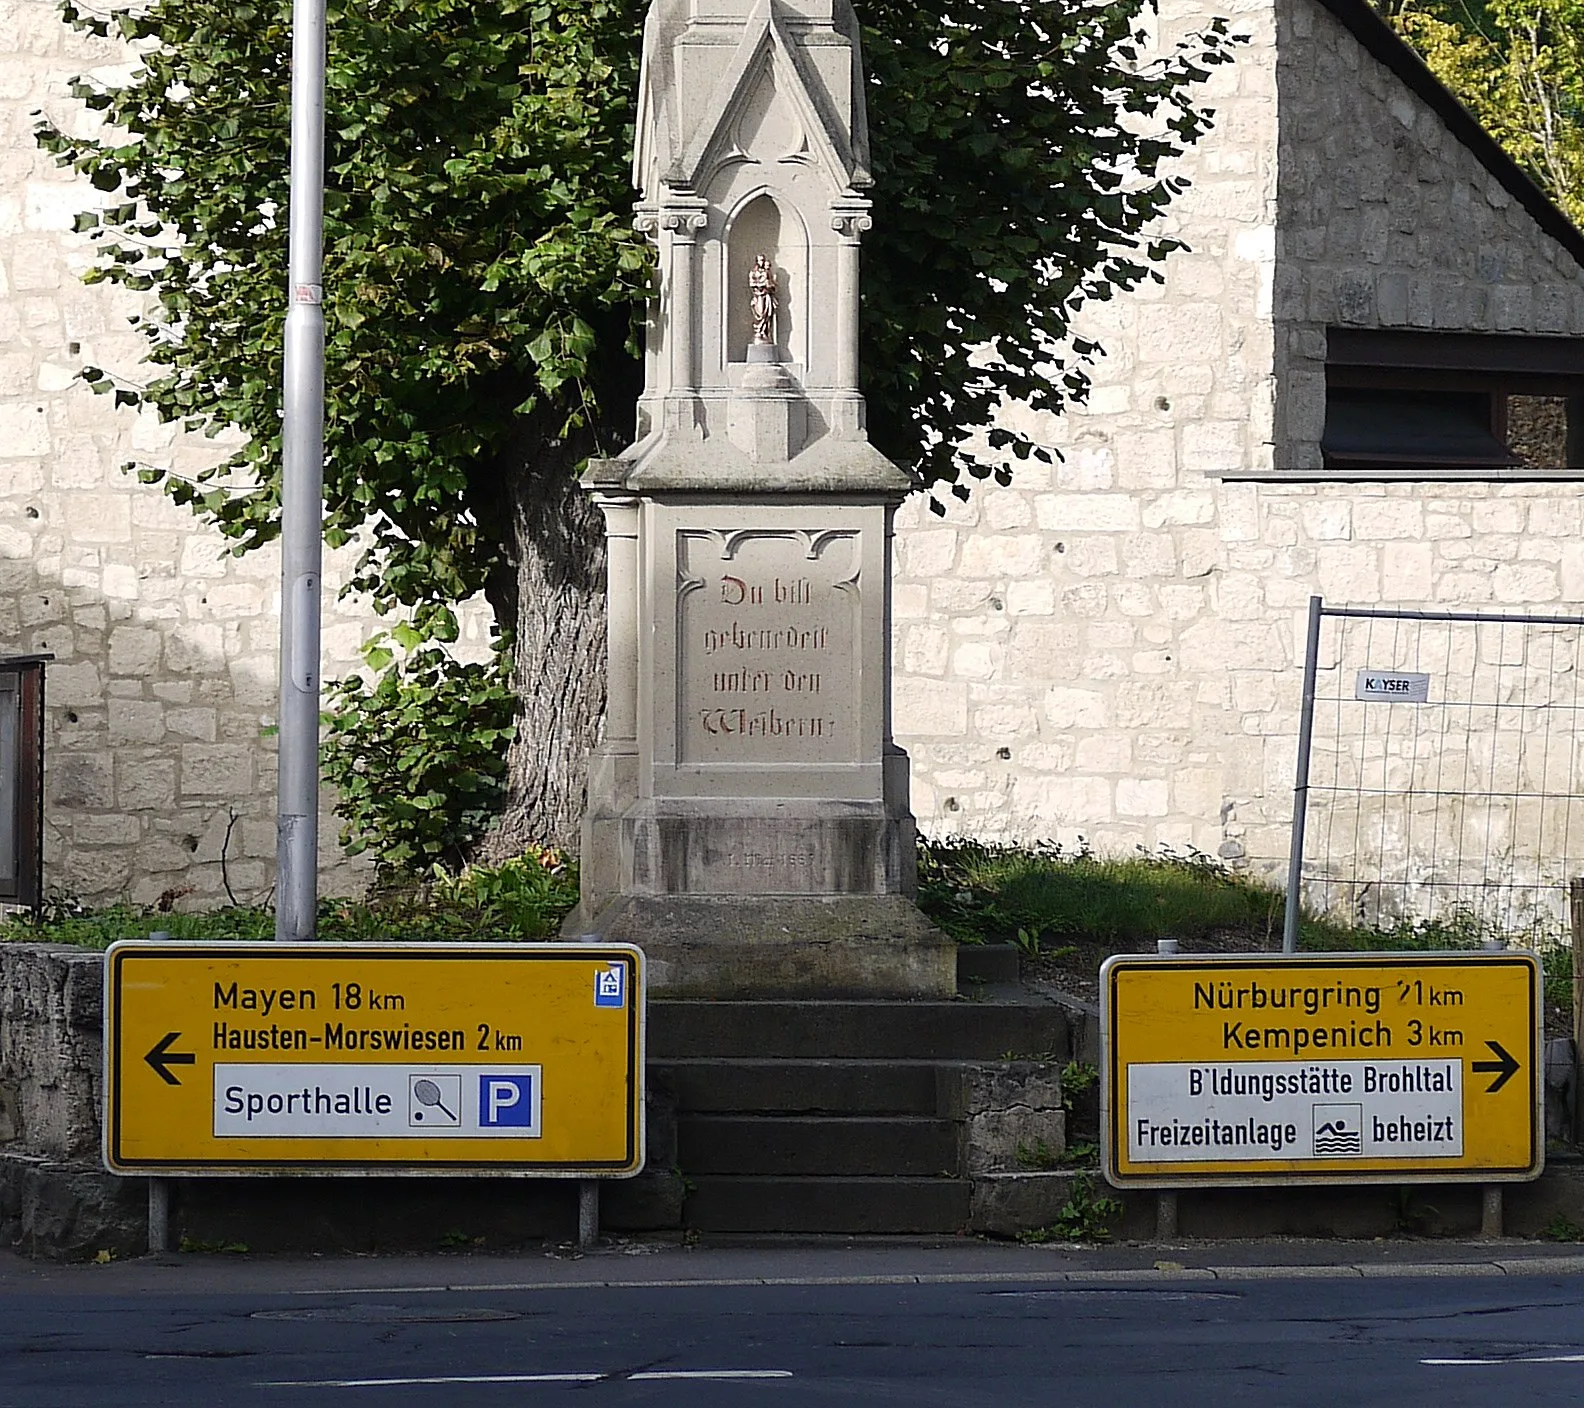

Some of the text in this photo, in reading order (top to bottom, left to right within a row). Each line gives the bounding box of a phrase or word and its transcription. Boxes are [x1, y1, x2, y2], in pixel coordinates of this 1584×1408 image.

[721, 574, 763, 605] Du
[783, 668, 823, 694] den
[1365, 678, 1410, 691] KAYSER
[213, 982, 405, 1016] Mayen 18 km
[1193, 981, 1381, 1015] Nürburgring
[1429, 985, 1464, 1006] km
[213, 1021, 522, 1051] Hausten-Morswiesen 2 km
[1223, 1020, 1464, 1055] Kempenich 3 km
[1363, 1065, 1453, 1093] Brohltal
[224, 1081, 521, 1123] Sporthalle P
[1137, 1114, 1455, 1152] Freizeitanlage beheizt
